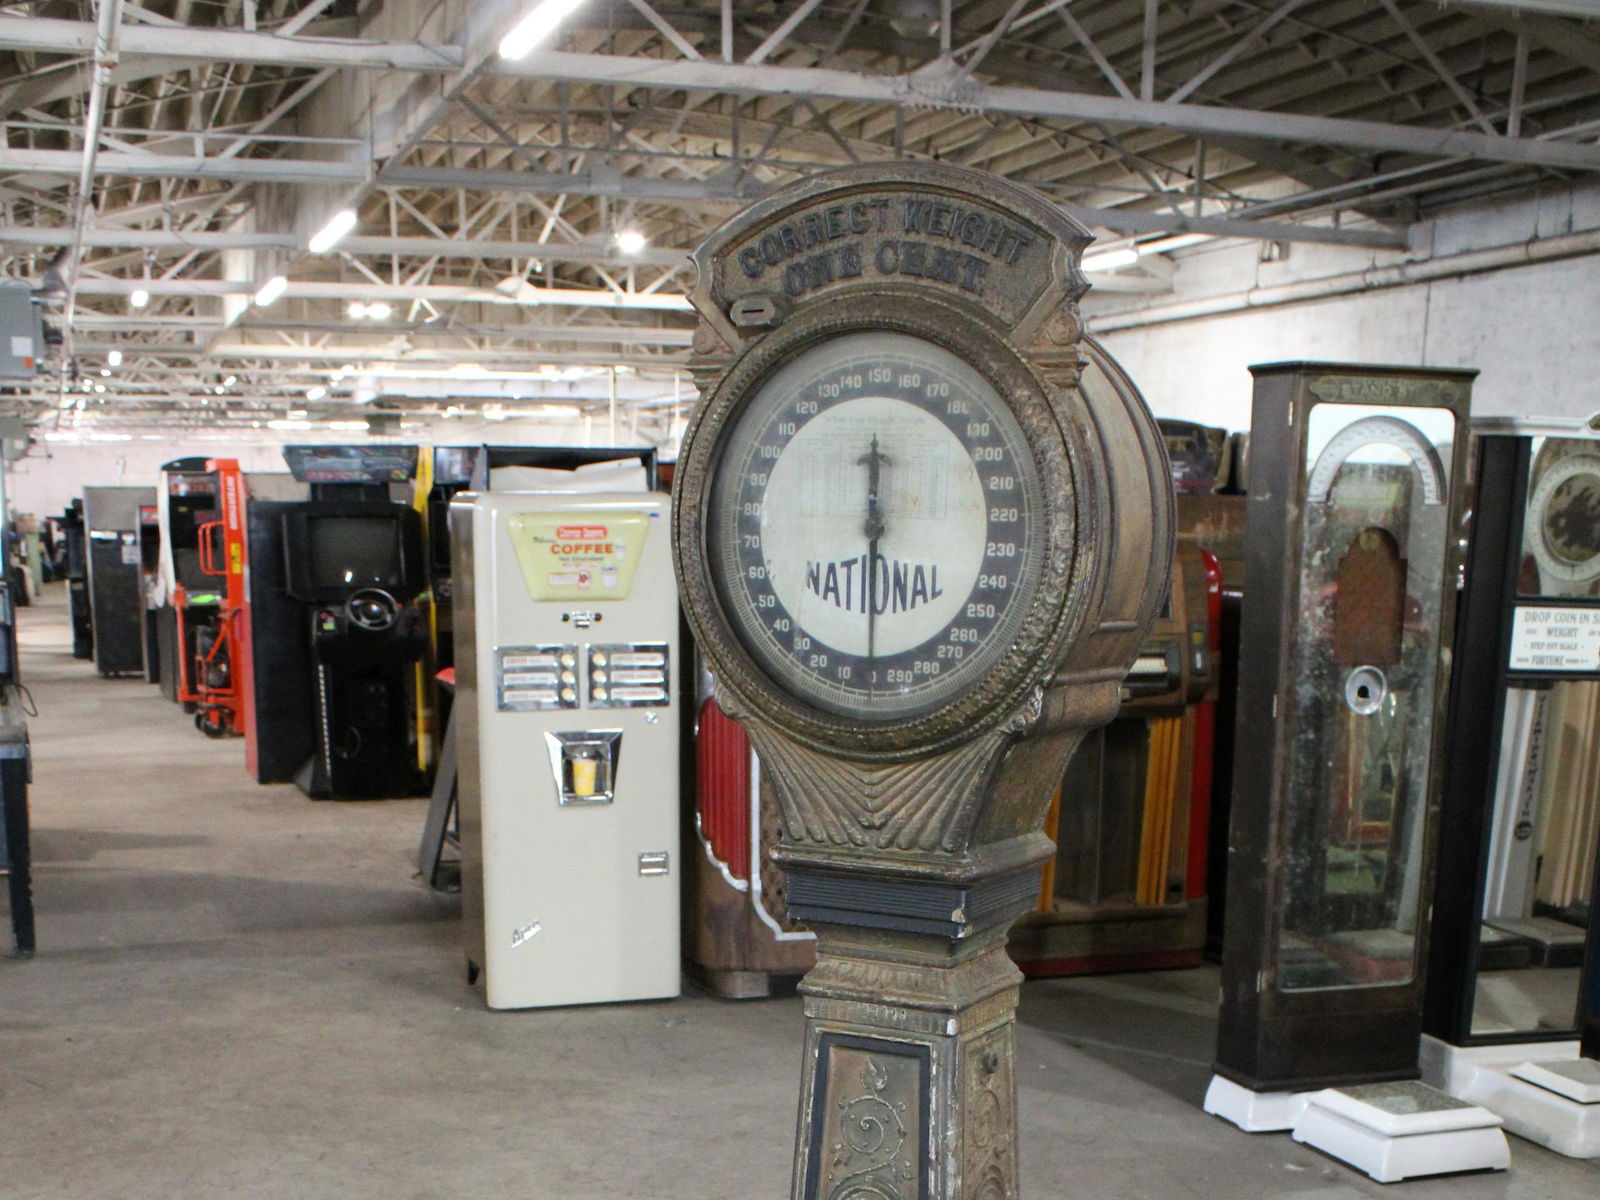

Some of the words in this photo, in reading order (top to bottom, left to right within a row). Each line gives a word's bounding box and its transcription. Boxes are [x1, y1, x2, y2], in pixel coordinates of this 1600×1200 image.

[738, 199, 889, 279] CORRECT
[902, 200, 1035, 265] WEIGHT
[784, 242, 864, 297] ONE
[873, 239, 990, 298] CENT
[841, 375, 862, 389] 140
[869, 369, 891, 383] 150
[899, 374, 921, 388] 160
[818, 384, 840, 398] 130
[926, 383, 949, 397] 170
[796, 401, 818, 414] 120
[779, 423, 796, 435] 110
[761, 446, 781, 458] 100
[975, 447, 1003, 461] 200
[750, 473, 767, 486] 90
[990, 476, 1014, 490] 210
[744, 503, 761, 516] 80
[990, 508, 1018, 522] 220
[744, 535, 760, 548] 70
[551, 543, 614, 555] COFFEE
[986, 543, 1015, 557] 230
[749, 566, 766, 579] 60
[806, 553, 943, 616] NATIONAL
[979, 575, 1007, 589] 240
[758, 595, 775, 607] 50
[967, 604, 995, 617] 250
[1525, 611, 1552, 623] DROP
[1554, 612, 1577, 624] COIN
[1579, 613, 1590, 624] IN
[773, 619, 790, 632] 40
[950, 628, 978, 642] 260
[1547, 627, 1579, 638] WEIGHT
[794, 637, 811, 650] 30
[937, 645, 963, 659] 270
[810, 654, 828, 667] 20
[838, 666, 851, 679] 10
[914, 661, 940, 674] 280
[887, 669, 913, 683] 290
